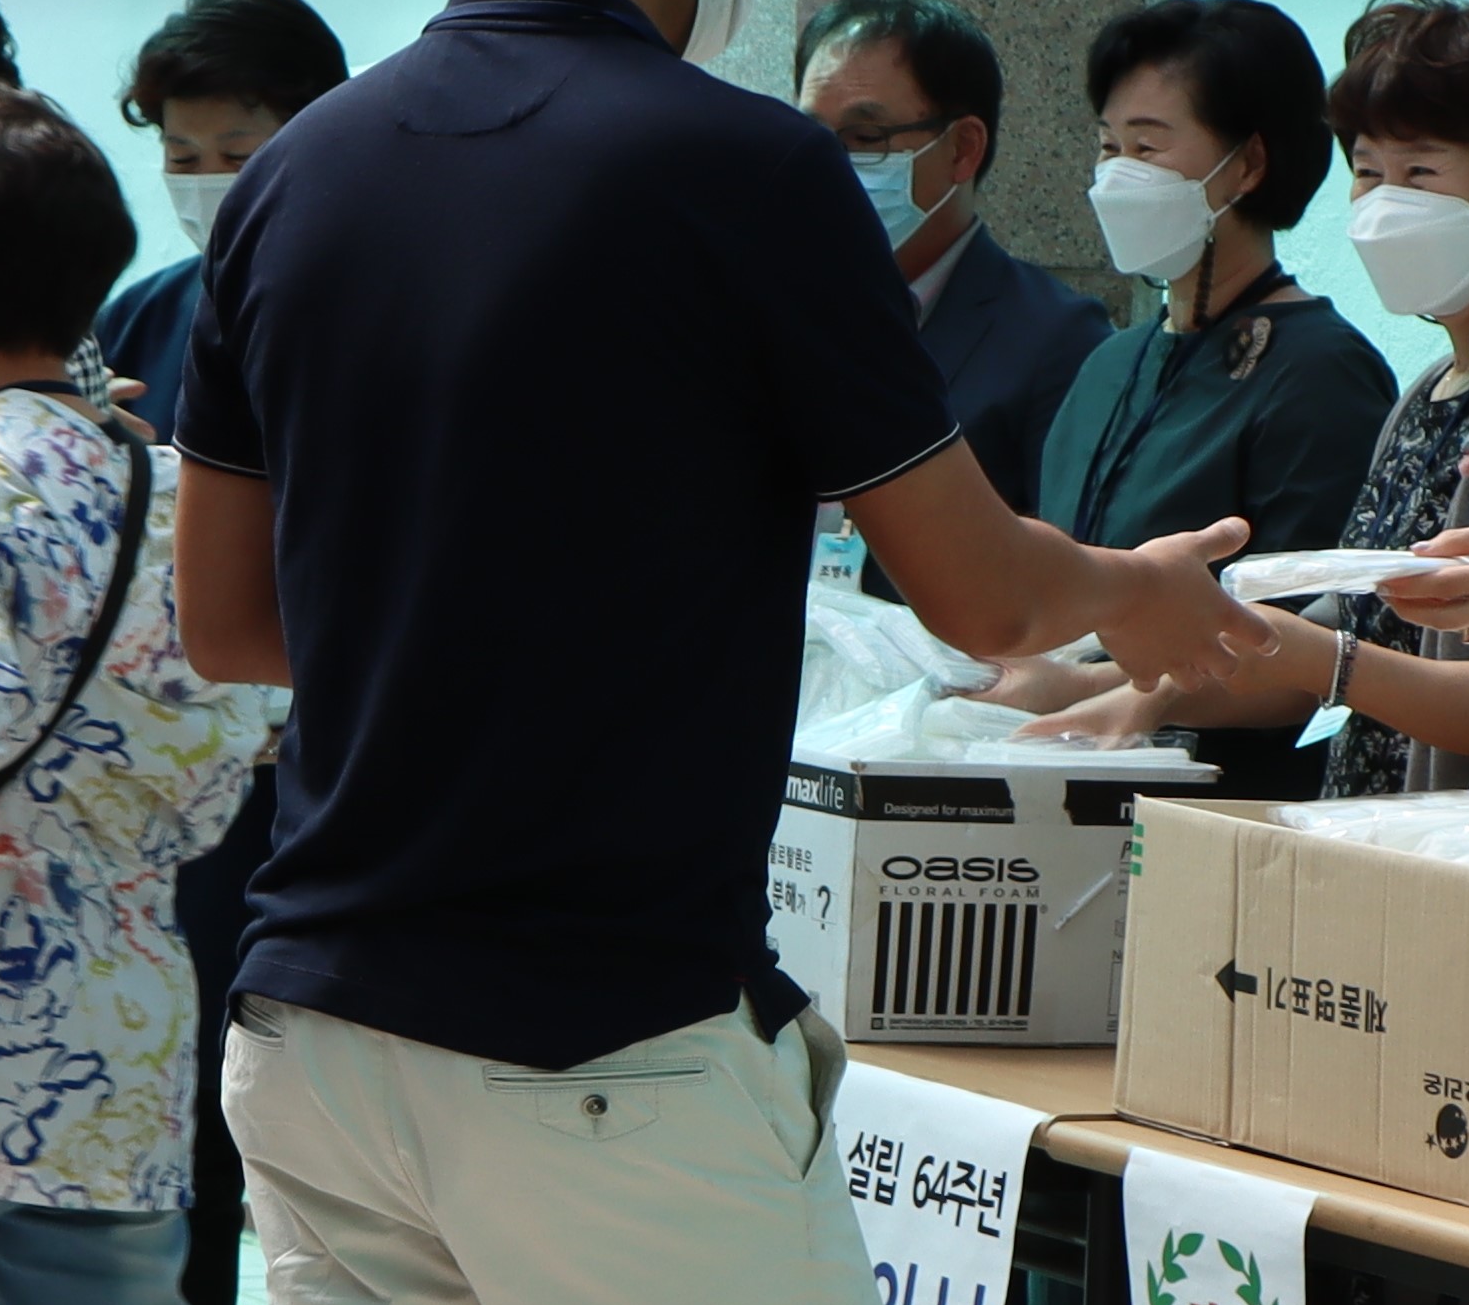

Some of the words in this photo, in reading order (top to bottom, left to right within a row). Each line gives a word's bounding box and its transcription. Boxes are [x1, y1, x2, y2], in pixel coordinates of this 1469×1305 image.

[884, 802, 939, 817] Designed
[942, 803, 958, 815] for
[880, 886, 966, 898] FLORAL
[980, 886, 1040, 899] FOAM
[1267, 967, 1388, 1033] 제품명표기
[848, 1130, 904, 1207] 설립
[912, 1154, 1008, 1239] 64주년
